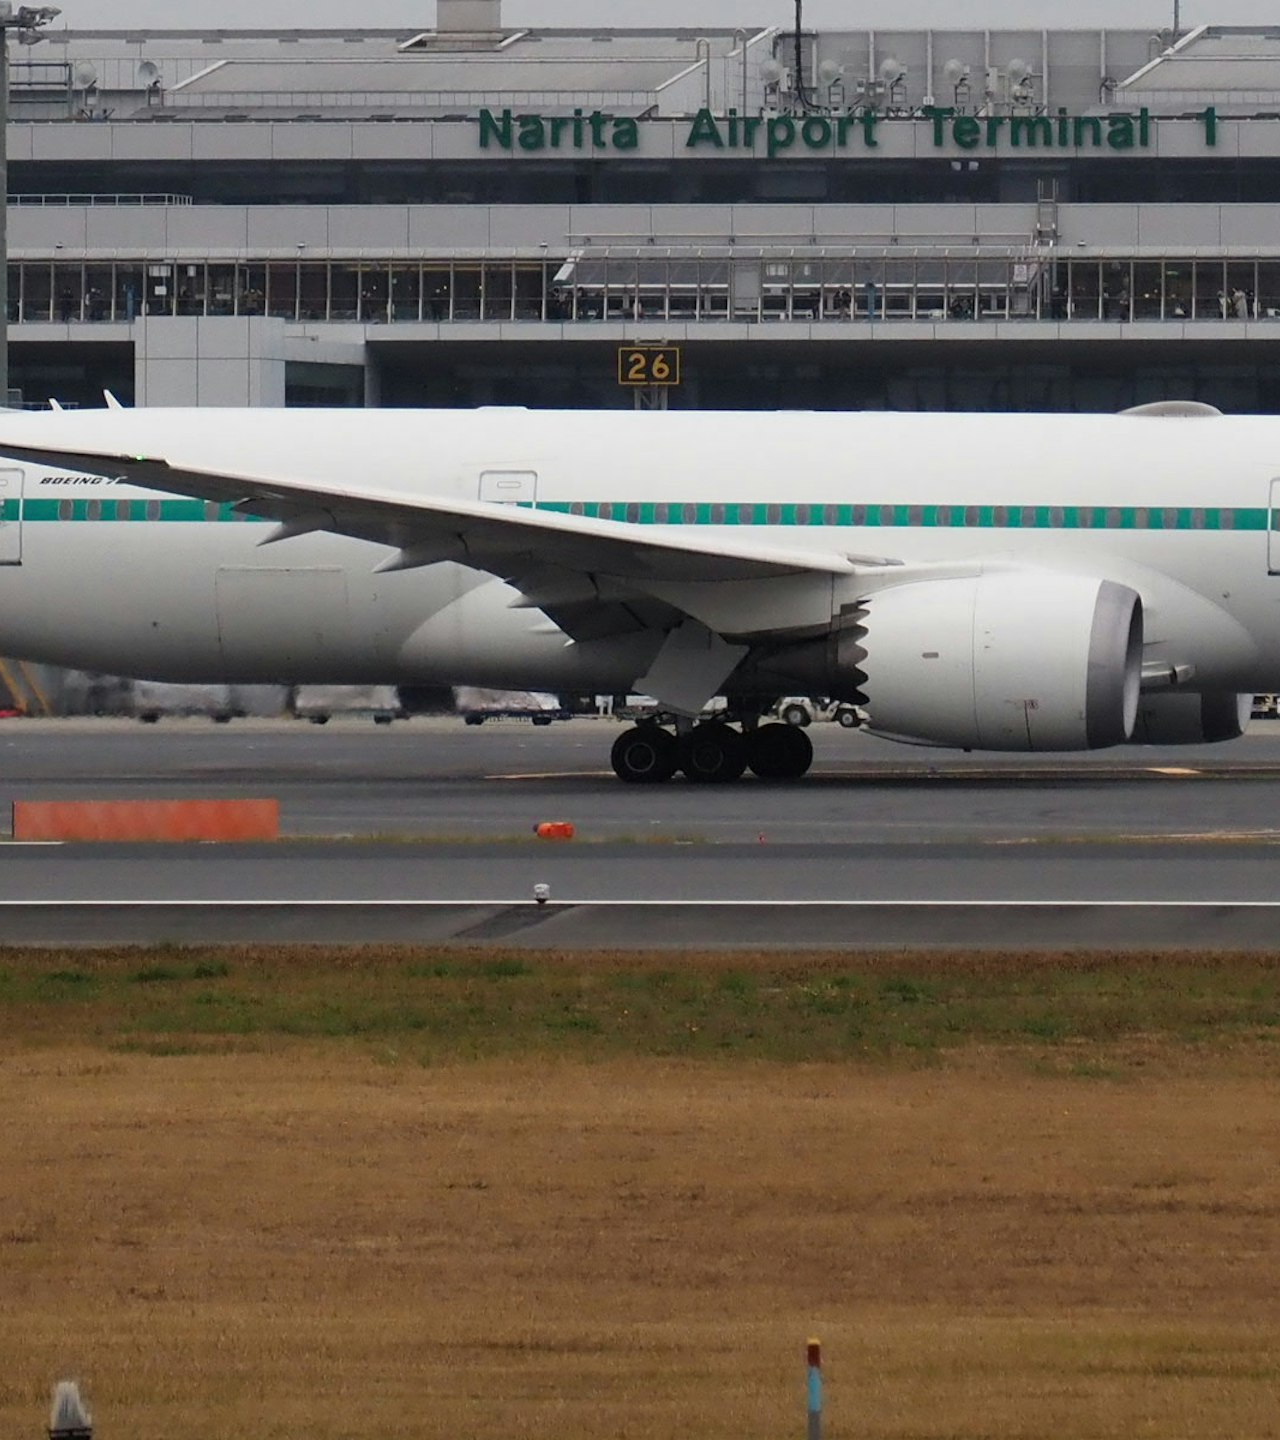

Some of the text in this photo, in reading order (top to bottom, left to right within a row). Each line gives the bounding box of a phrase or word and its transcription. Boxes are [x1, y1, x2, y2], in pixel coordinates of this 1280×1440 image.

[479, 107, 1216, 158] Narita Airport Terminal 1
[628, 353, 670, 379] 26
[40, 477, 103, 485] BOEING
